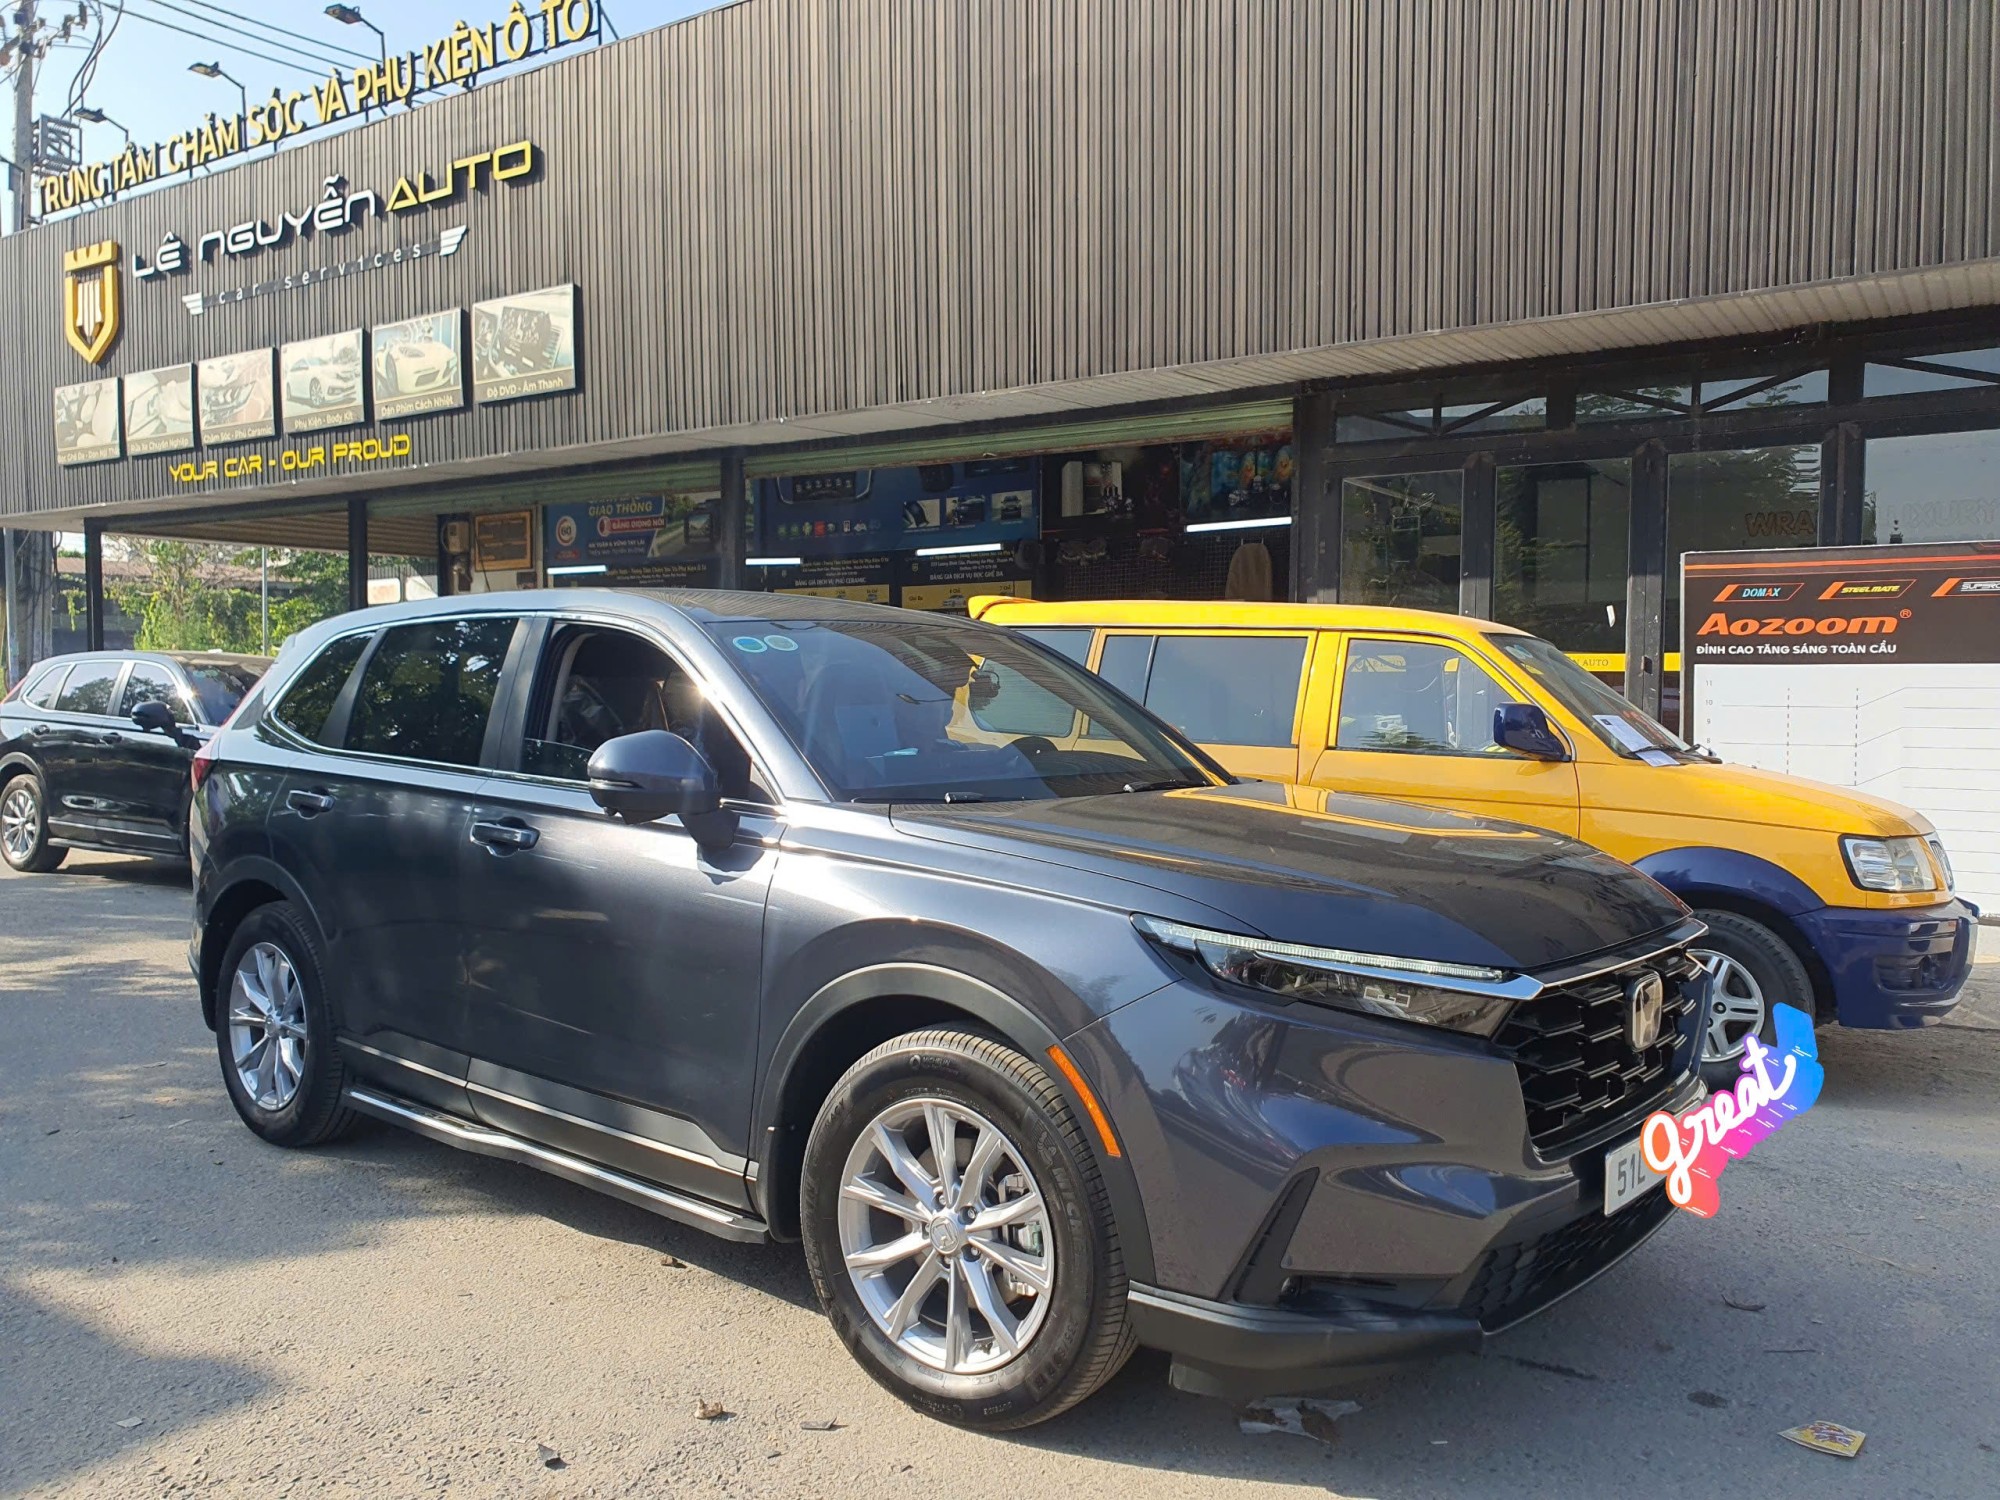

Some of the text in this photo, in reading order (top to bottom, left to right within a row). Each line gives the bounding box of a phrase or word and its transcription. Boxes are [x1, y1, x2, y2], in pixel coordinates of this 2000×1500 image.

[112, 142, 157, 192] TÂM
[166, 114, 240, 172] CHĂM
[247, 87, 303, 147] SÓC
[312, 68, 348, 122] VÀ
[354, 53, 413, 112] PHỤ
[424, 20, 495, 88] KIỆN
[504, 0, 530, 60] Ô
[132, 231, 182, 279] LÊ
[385, 140, 532, 212] AUTO
[218, 243, 423, 304] car services
[499, 384, 517, 396] DVD
[538, 376, 564, 390] Thanh
[169, 434, 411, 482] YOUR CAR OUR PROUD
[588, 504, 613, 516] GIAO
[616, 498, 653, 514] THÔNG
[1741, 587, 1781, 598] DOMAX
[1728, 645, 1754, 655] CAO
[1757, 642, 1791, 655] TĂNG
[1792, 642, 1829, 655] SÁNG
[1831, 641, 1868, 654] TOÀN
[1869, 639, 1897, 654] CẦU
